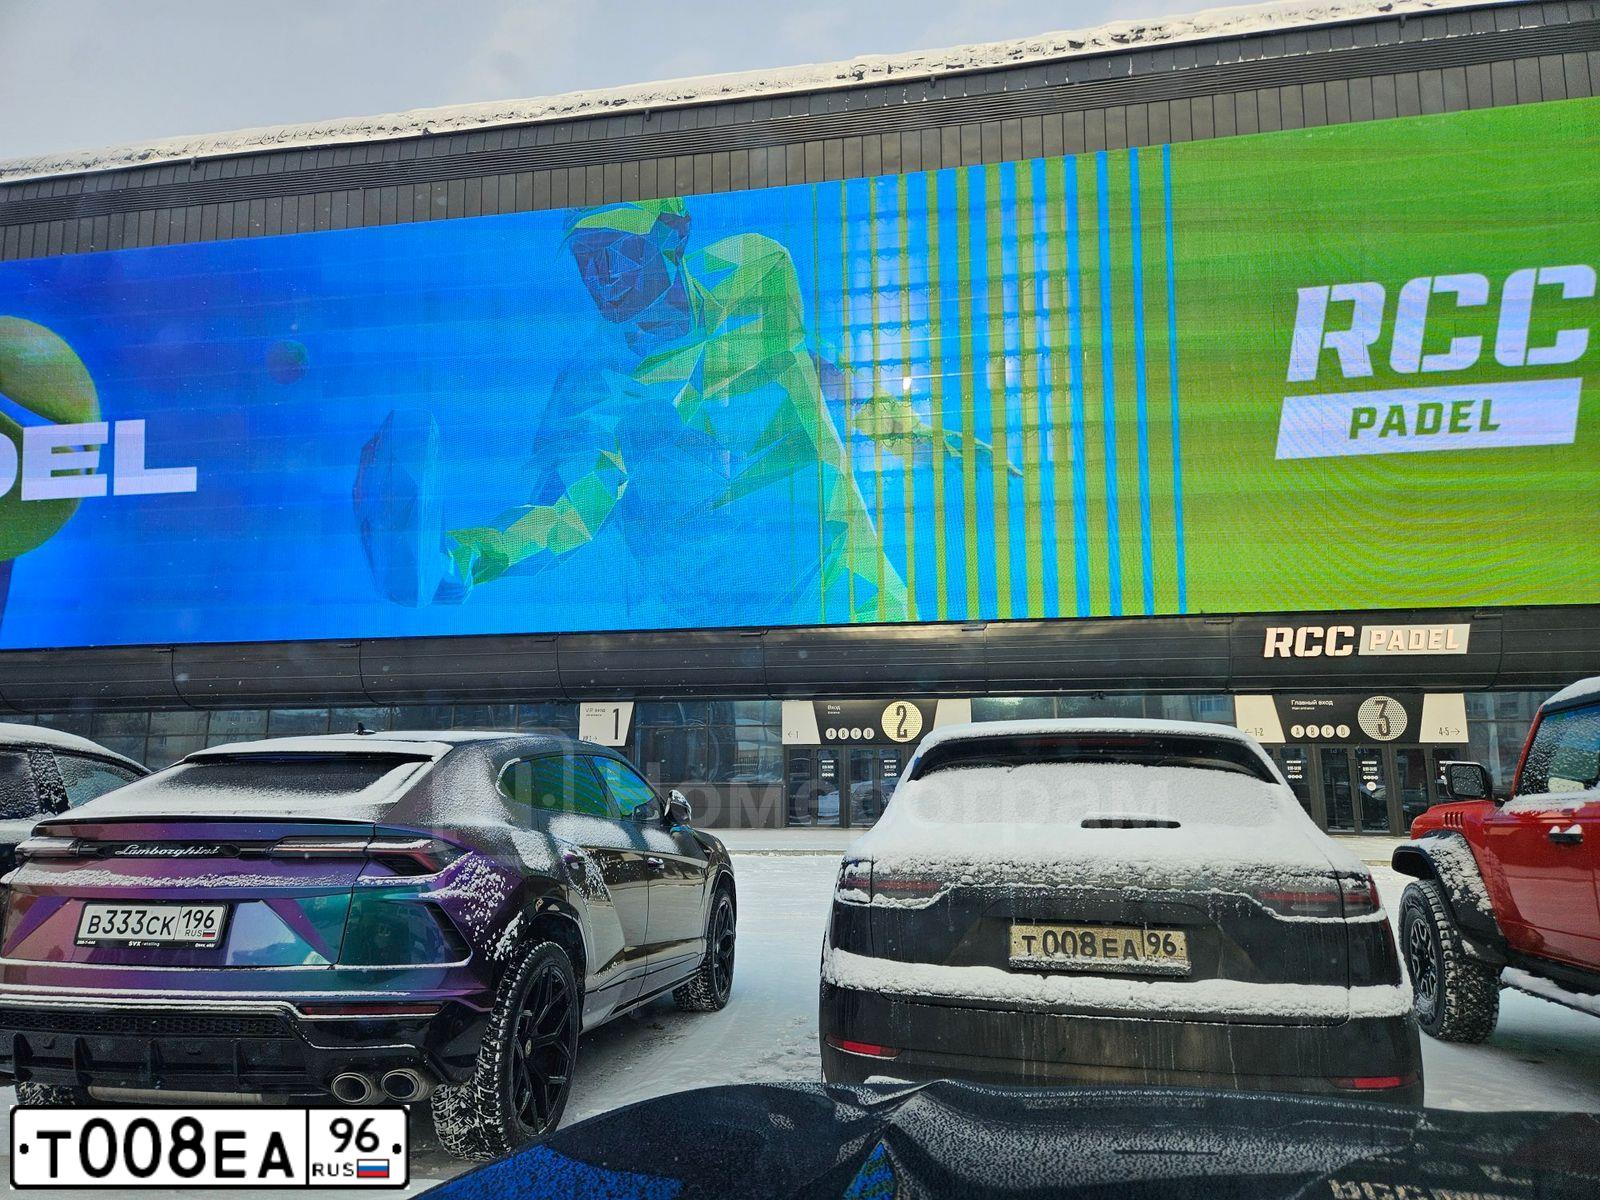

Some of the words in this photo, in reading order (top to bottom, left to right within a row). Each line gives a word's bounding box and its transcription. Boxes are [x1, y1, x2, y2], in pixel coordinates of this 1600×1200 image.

[1287, 264, 1597, 382] RCC
[1349, 399, 1501, 440] PADEL
[0, 419, 197, 501] EL
[1264, 625, 1355, 658] RCC
[1369, 629, 1460, 651] PADEL
[612, 708, 619, 740] 1
[896, 704, 908, 738] 2
[1375, 700, 1391, 736] 3
[1438, 727, 1450, 736] 4-5
[115, 844, 220, 857] Lamborghini
[87, 909, 176, 936] В333СК
[182, 909, 215, 929] 196
[185, 929, 202, 937] RUS
[1021, 930, 1139, 961] Т008ЕА
[1146, 932, 1177, 957] 96
